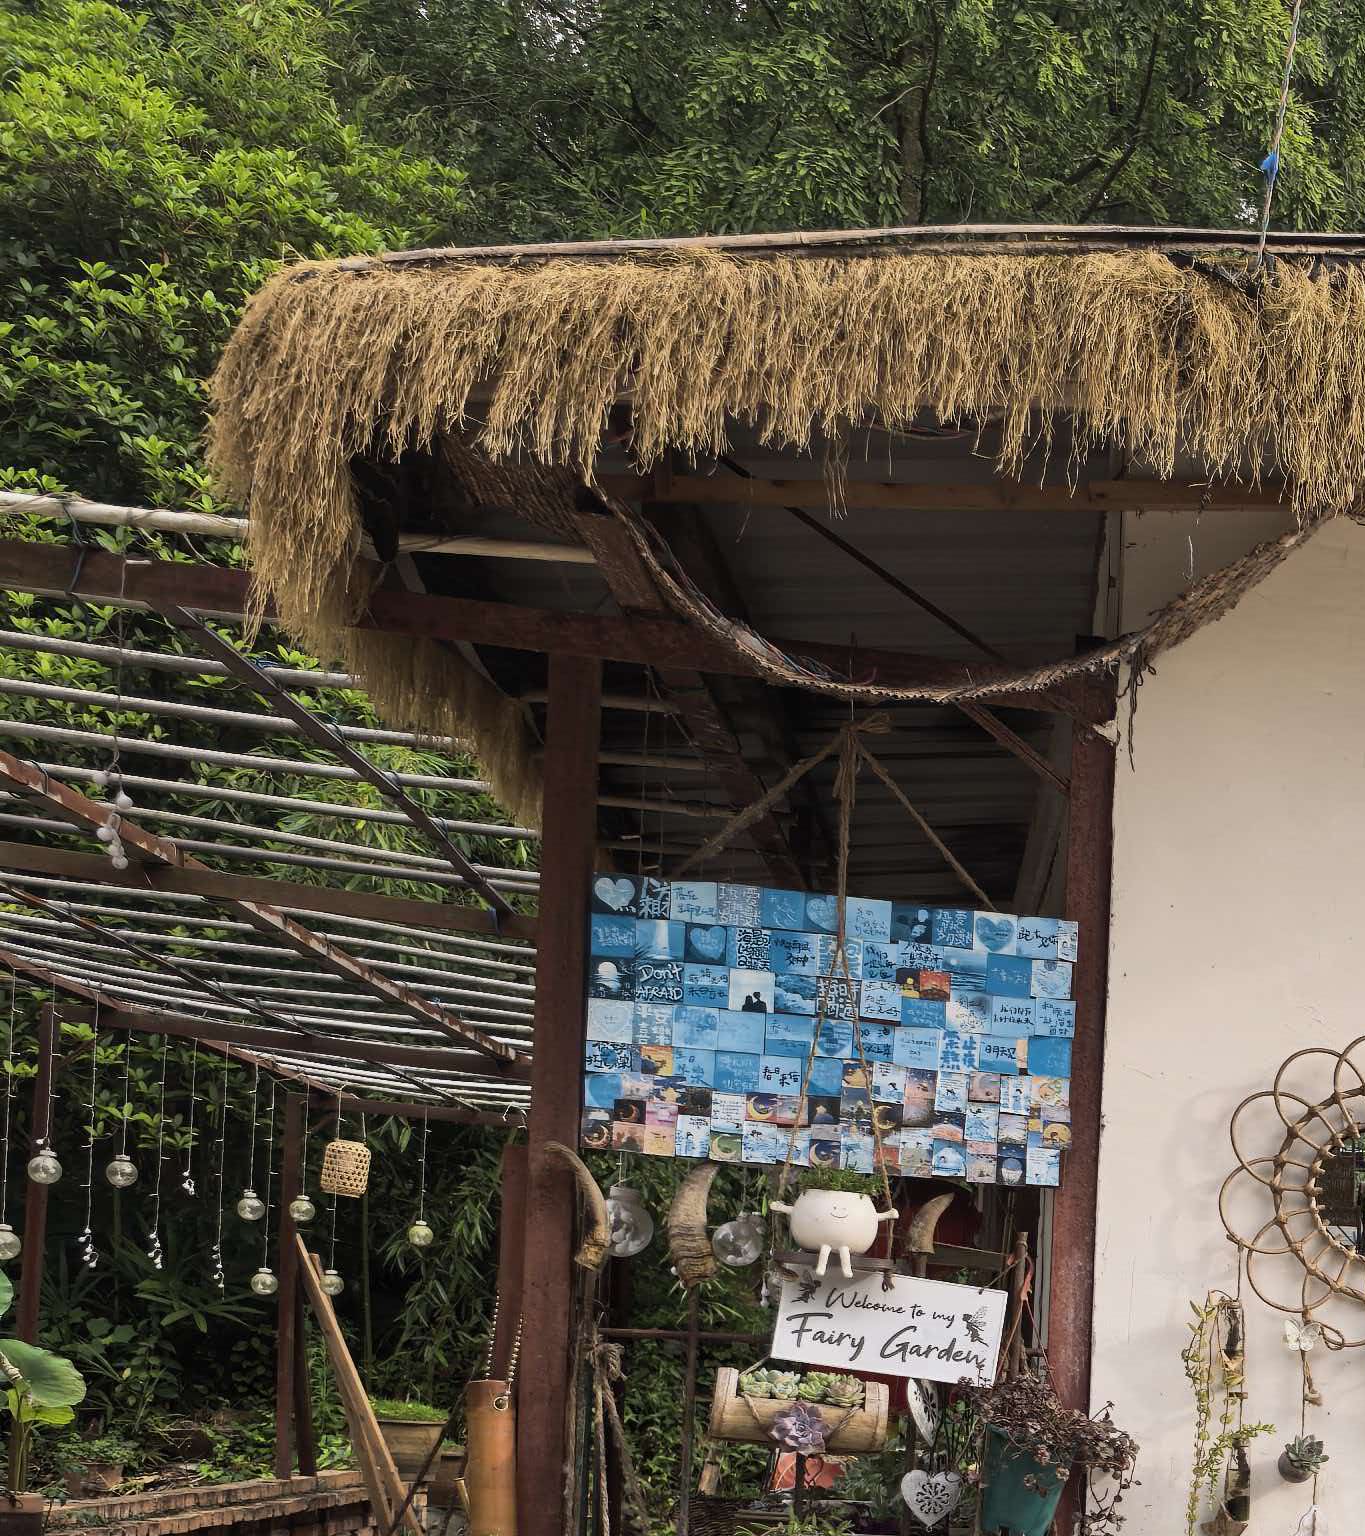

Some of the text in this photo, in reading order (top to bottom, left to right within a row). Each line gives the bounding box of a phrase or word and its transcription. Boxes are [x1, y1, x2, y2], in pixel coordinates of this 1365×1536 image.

[639, 963, 683, 982] Don't
[635, 985, 683, 1001] AFRAID
[825, 1287, 955, 1329] Welcome to my
[785, 1312, 986, 1366] Fairy Garden
